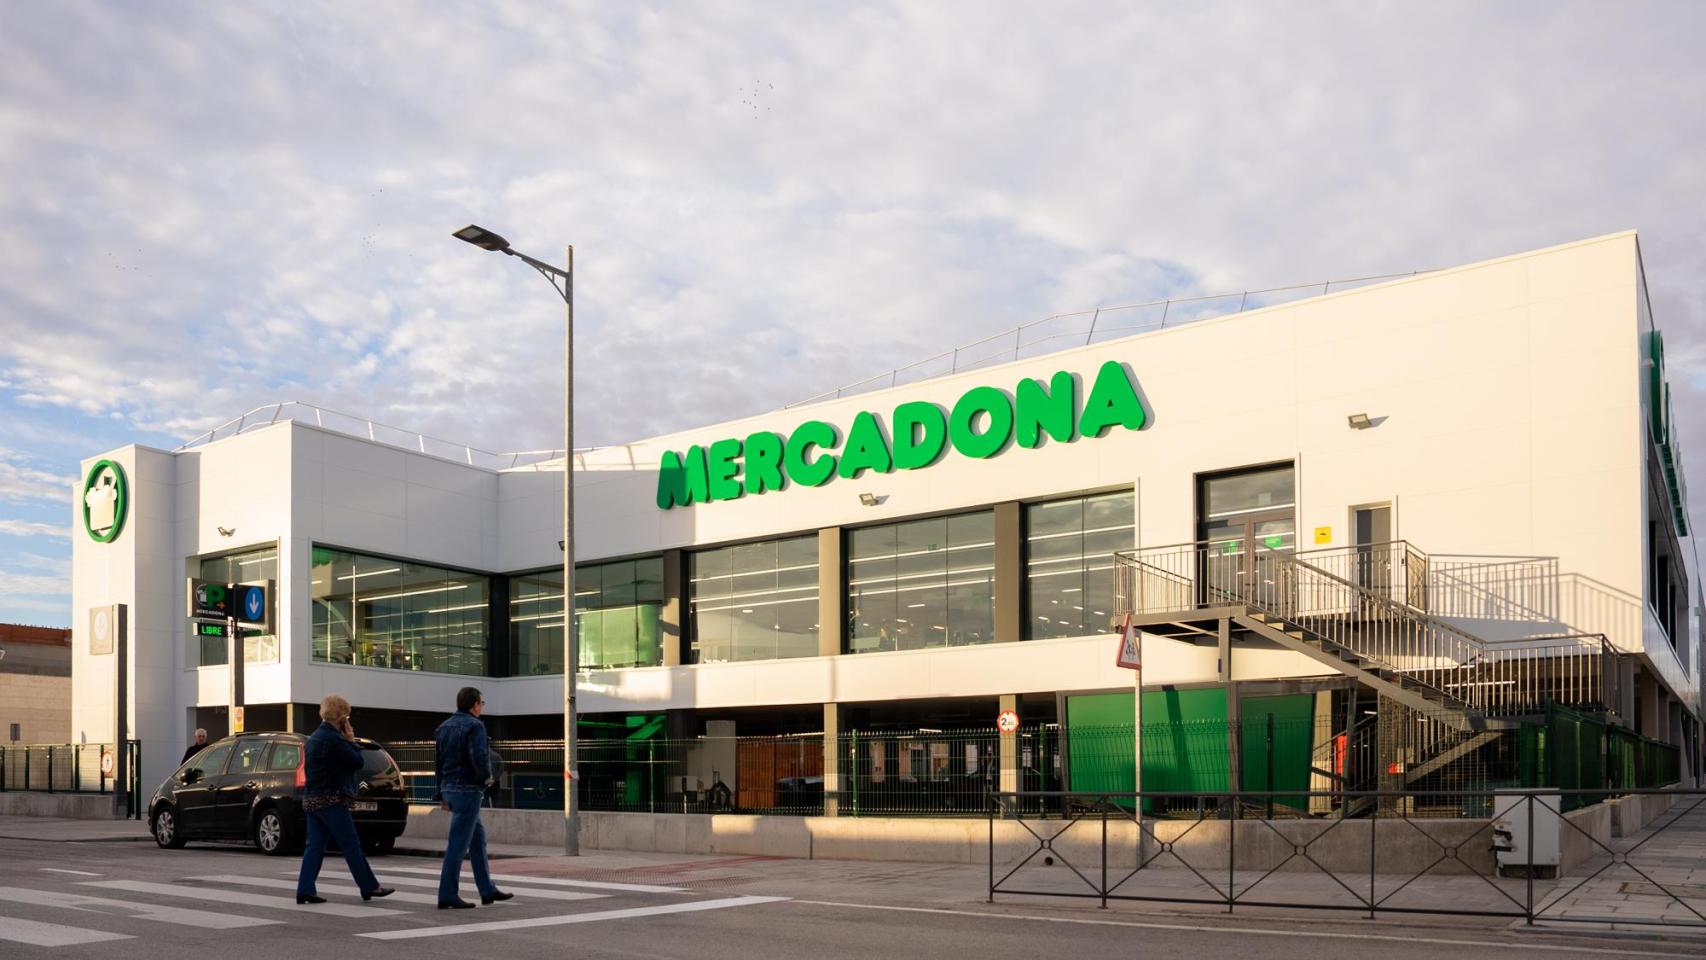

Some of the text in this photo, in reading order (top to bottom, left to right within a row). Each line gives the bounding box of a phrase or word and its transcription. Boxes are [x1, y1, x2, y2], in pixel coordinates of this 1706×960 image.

[656, 361, 1148, 510] MERCADONA
[207, 584, 225, 608] P
[201, 625, 223, 636] LIBRE
